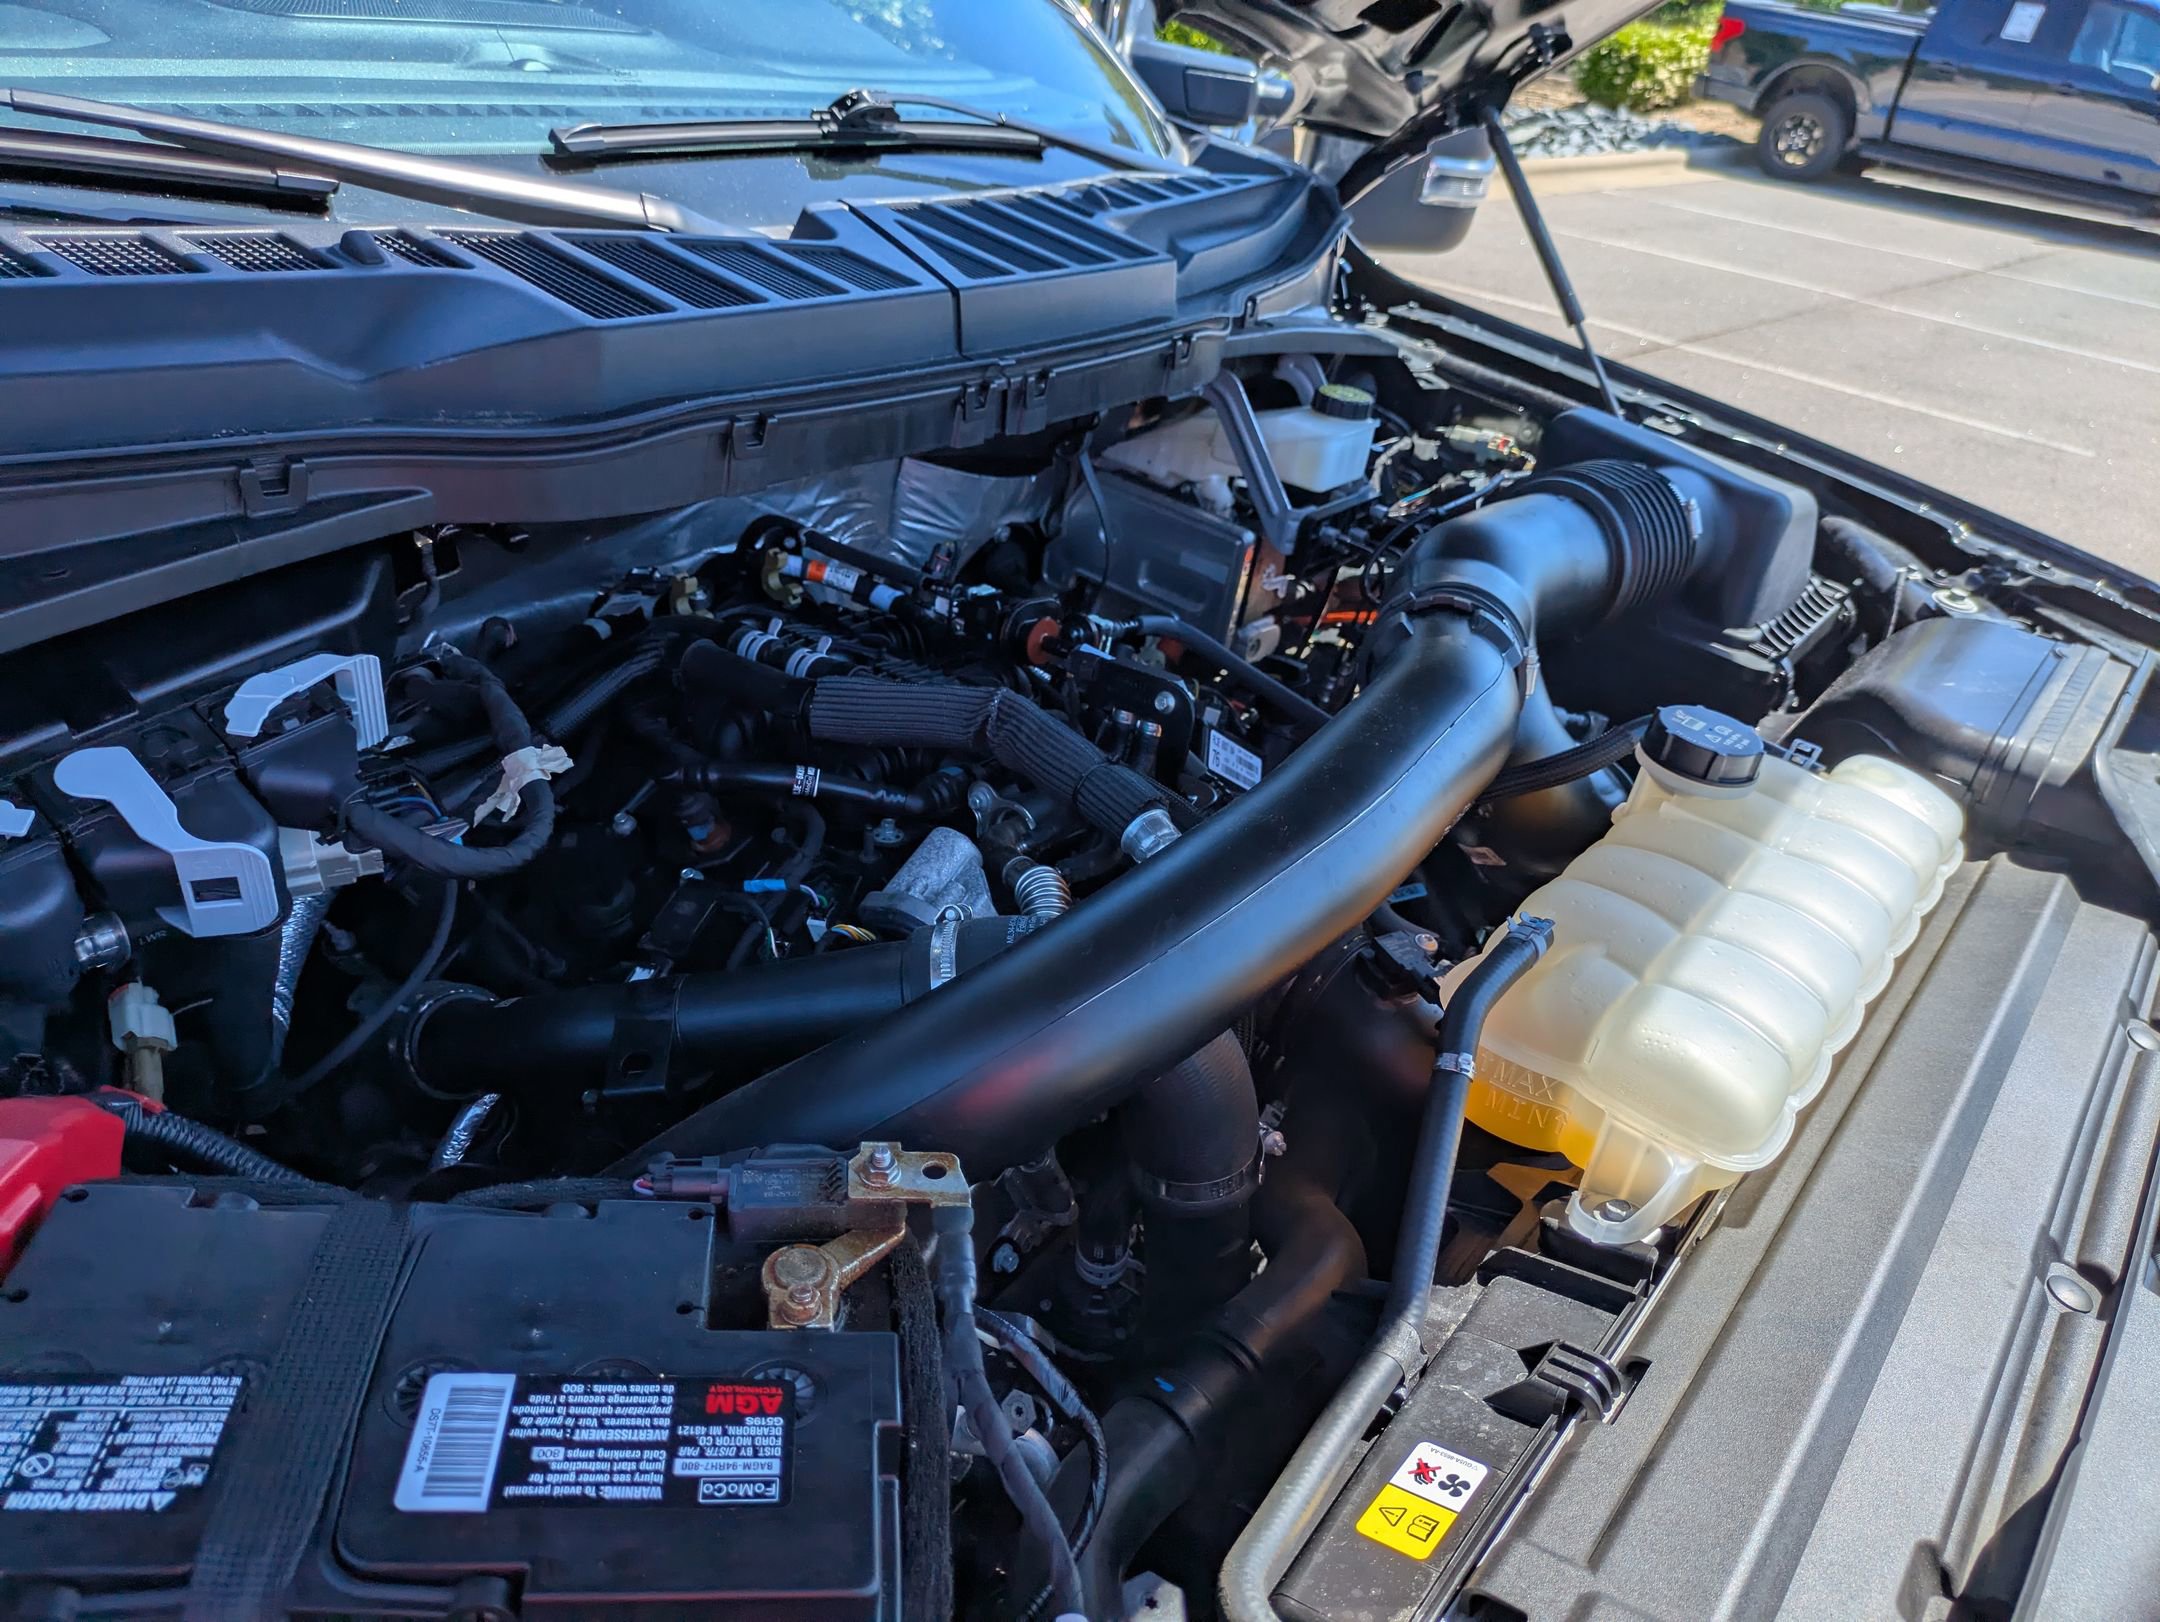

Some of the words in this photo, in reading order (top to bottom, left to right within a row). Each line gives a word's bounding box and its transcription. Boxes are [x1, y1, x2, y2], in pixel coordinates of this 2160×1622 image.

[1494, 1061, 1559, 1102] MAX
[1485, 1087, 1551, 1129] MIN
[165, 1376, 179, 1386] LA
[178, 1375, 212, 1386] OUVRIR
[211, 1375, 231, 1386] PAS
[229, 1375, 243, 1386] NE
[162, 1386, 175, 1396] LA
[175, 1386, 188, 1396] DE
[187, 1386, 213, 1396] HORS
[211, 1386, 237, 1396] TENIR
[561, 1384, 585, 1393] 800
[592, 1384, 628, 1393] volants
[629, 1384, 660, 1394] cables
[662, 1384, 674, 1393] de
[709, 1385, 784, 1395] TECHNOLOGY
[138, 1396, 167, 1405] REACH
[166, 1396, 182, 1405] THE
[182, 1396, 196, 1405] OF
[195, 1396, 213, 1405] OUT
[212, 1396, 234, 1406] KEEP
[567, 1394, 606, 1403] secours
[660, 1395, 673, 1405] de
[706, 1394, 783, 1415] AGM
[557, 1406, 567, 1415] la
[519, 1416, 535, 1426] du
[535, 1416, 563, 1426] guide
[577, 1417, 598, 1427] Voir
[600, 1417, 651, 1427] blessures.
[653, 1417, 671, 1427] des
[745, 1417, 784, 1426] G519S
[540, 1428, 564, 1438] Pour
[573, 1428, 670, 1441] AVERTISSEMENT
[678, 1426, 707, 1435] 48121
[709, 1426, 722, 1435] MI
[724, 1425, 783, 1436] DEARBORN,
[695, 1436, 714, 1446] CO.
[715, 1436, 752, 1446] MOTOR
[755, 1437, 782, 1446] FORD
[537, 1449, 561, 1458] 800
[567, 1448, 595, 1458] amps
[598, 1448, 641, 1460] cranking
[644, 1449, 667, 1460] Cold
[677, 1446, 700, 1456] PAR
[703, 1447, 737, 1456] DISTR.
[737, 1447, 753, 1456] BY
[756, 1447, 782, 1456] DIST.
[548, 1461, 611, 1471] instructions.
[613, 1461, 637, 1471] start
[639, 1460, 665, 1471] jump
[681, 1461, 774, 1471] BAGM-94RH7-800
[527, 1473, 544, 1483] for
[546, 1471, 576, 1483] guide
[577, 1473, 610, 1482] owner
[612, 1473, 631, 1482] see
[633, 1472, 663, 1483] injury
[503, 1484, 551, 1498] personal
[552, 1485, 583, 1497] avoid
[583, 1485, 598, 1497] To
[599, 1485, 663, 1500] WARNING:
[703, 1482, 777, 1497] FoMoCo
[3, 1491, 151, 1511] DANGER/POISON
